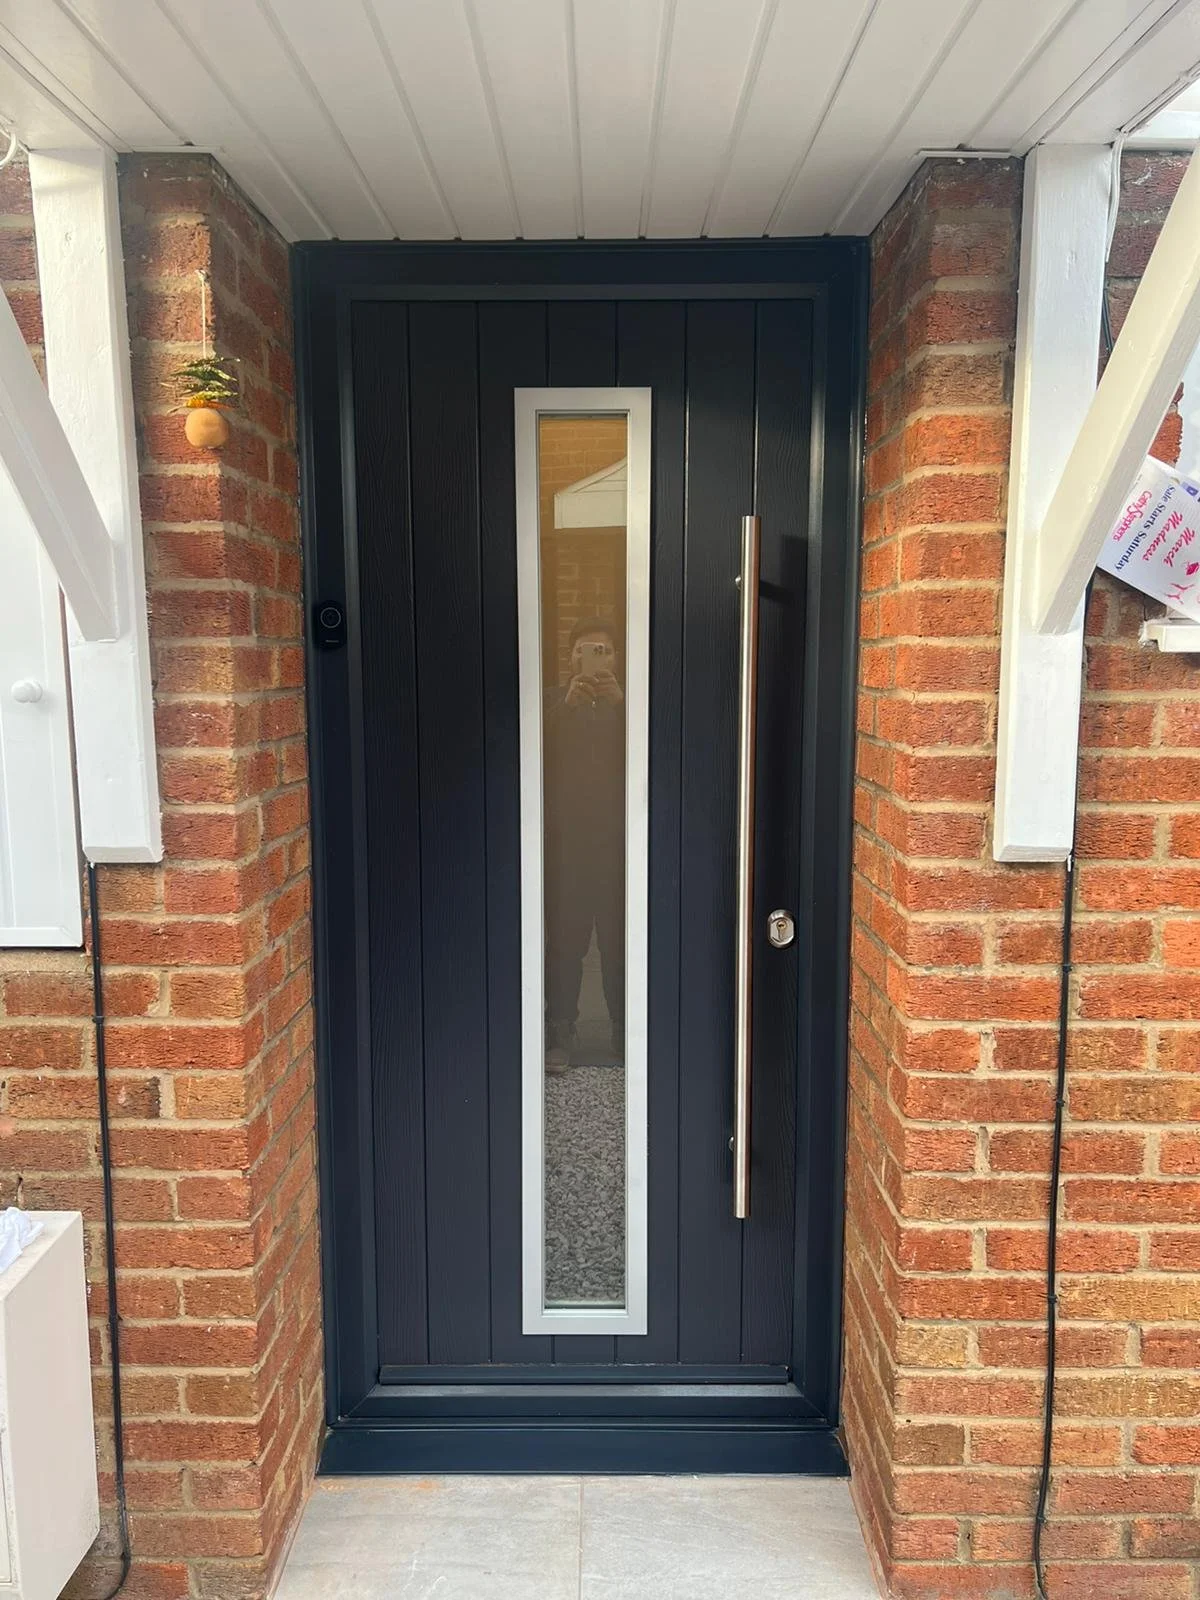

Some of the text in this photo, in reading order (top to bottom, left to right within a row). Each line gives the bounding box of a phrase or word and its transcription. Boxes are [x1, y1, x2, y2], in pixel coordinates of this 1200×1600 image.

[1115, 486, 1176, 570] Sale Starts Saturday
[1142, 511, 1183, 561] Madness
[1163, 527, 1195, 567] March
